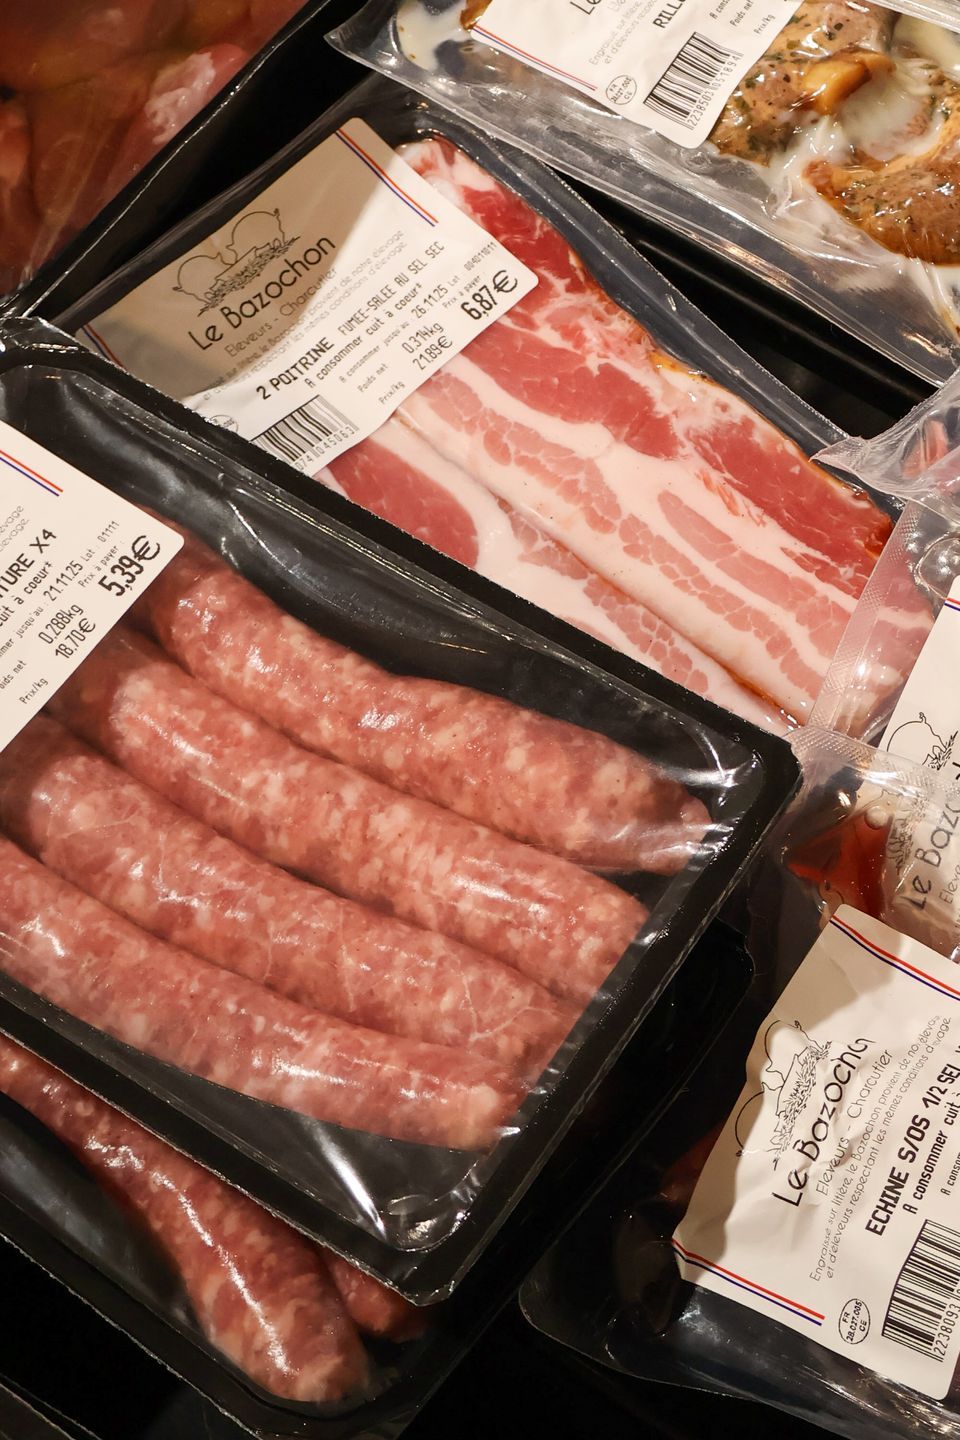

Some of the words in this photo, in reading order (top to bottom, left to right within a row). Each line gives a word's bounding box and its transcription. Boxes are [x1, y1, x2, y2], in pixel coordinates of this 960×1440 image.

[729, 11, 746, 27] Poids
[743, 0, 754, 11] net
[188, 325, 224, 351] Le
[220, 238, 335, 329] Bazochon
[224, 322, 273, 357] Eleveurs
[279, 268, 337, 317] Charcutier
[255, 385, 272, 400] 2
[269, 337, 334, 391] POITRINE
[393, 272, 410, 287] AU
[407, 258, 428, 275] SEL
[424, 241, 445, 259] SEC
[410, 284, 448, 319] 26.11.25
[461, 270, 518, 320] 6,87€
[316, 336, 362, 380] consommer
[365, 317, 385, 336] cuit
[29, 528, 57, 554] X4
[77, 573, 96, 588] Prix
[100, 545, 118, 567] payer
[98, 535, 161, 596] 5,39€
[43, 560, 83, 602] 21.11.25
[18, 678, 49, 704] Prix/kg
[816, 1137, 853, 1196] Eleveurs
[846, 1049, 893, 1119] Charcutier
[849, 1107, 882, 1162] Bazochon
[845, 1163, 859, 1175] le
[849, 1146, 879, 1206] respectant
[872, 1128, 887, 1145] les
[882, 1094, 903, 1127] mêmes
[865, 1167, 909, 1236] ECHINE
[897, 1114, 930, 1163] S/OS
[922, 1085, 948, 1109] 1/2
[913, 1130, 948, 1200] consommer
[772, 1169, 809, 1207] Le
[827, 1207, 838, 1225] sur
